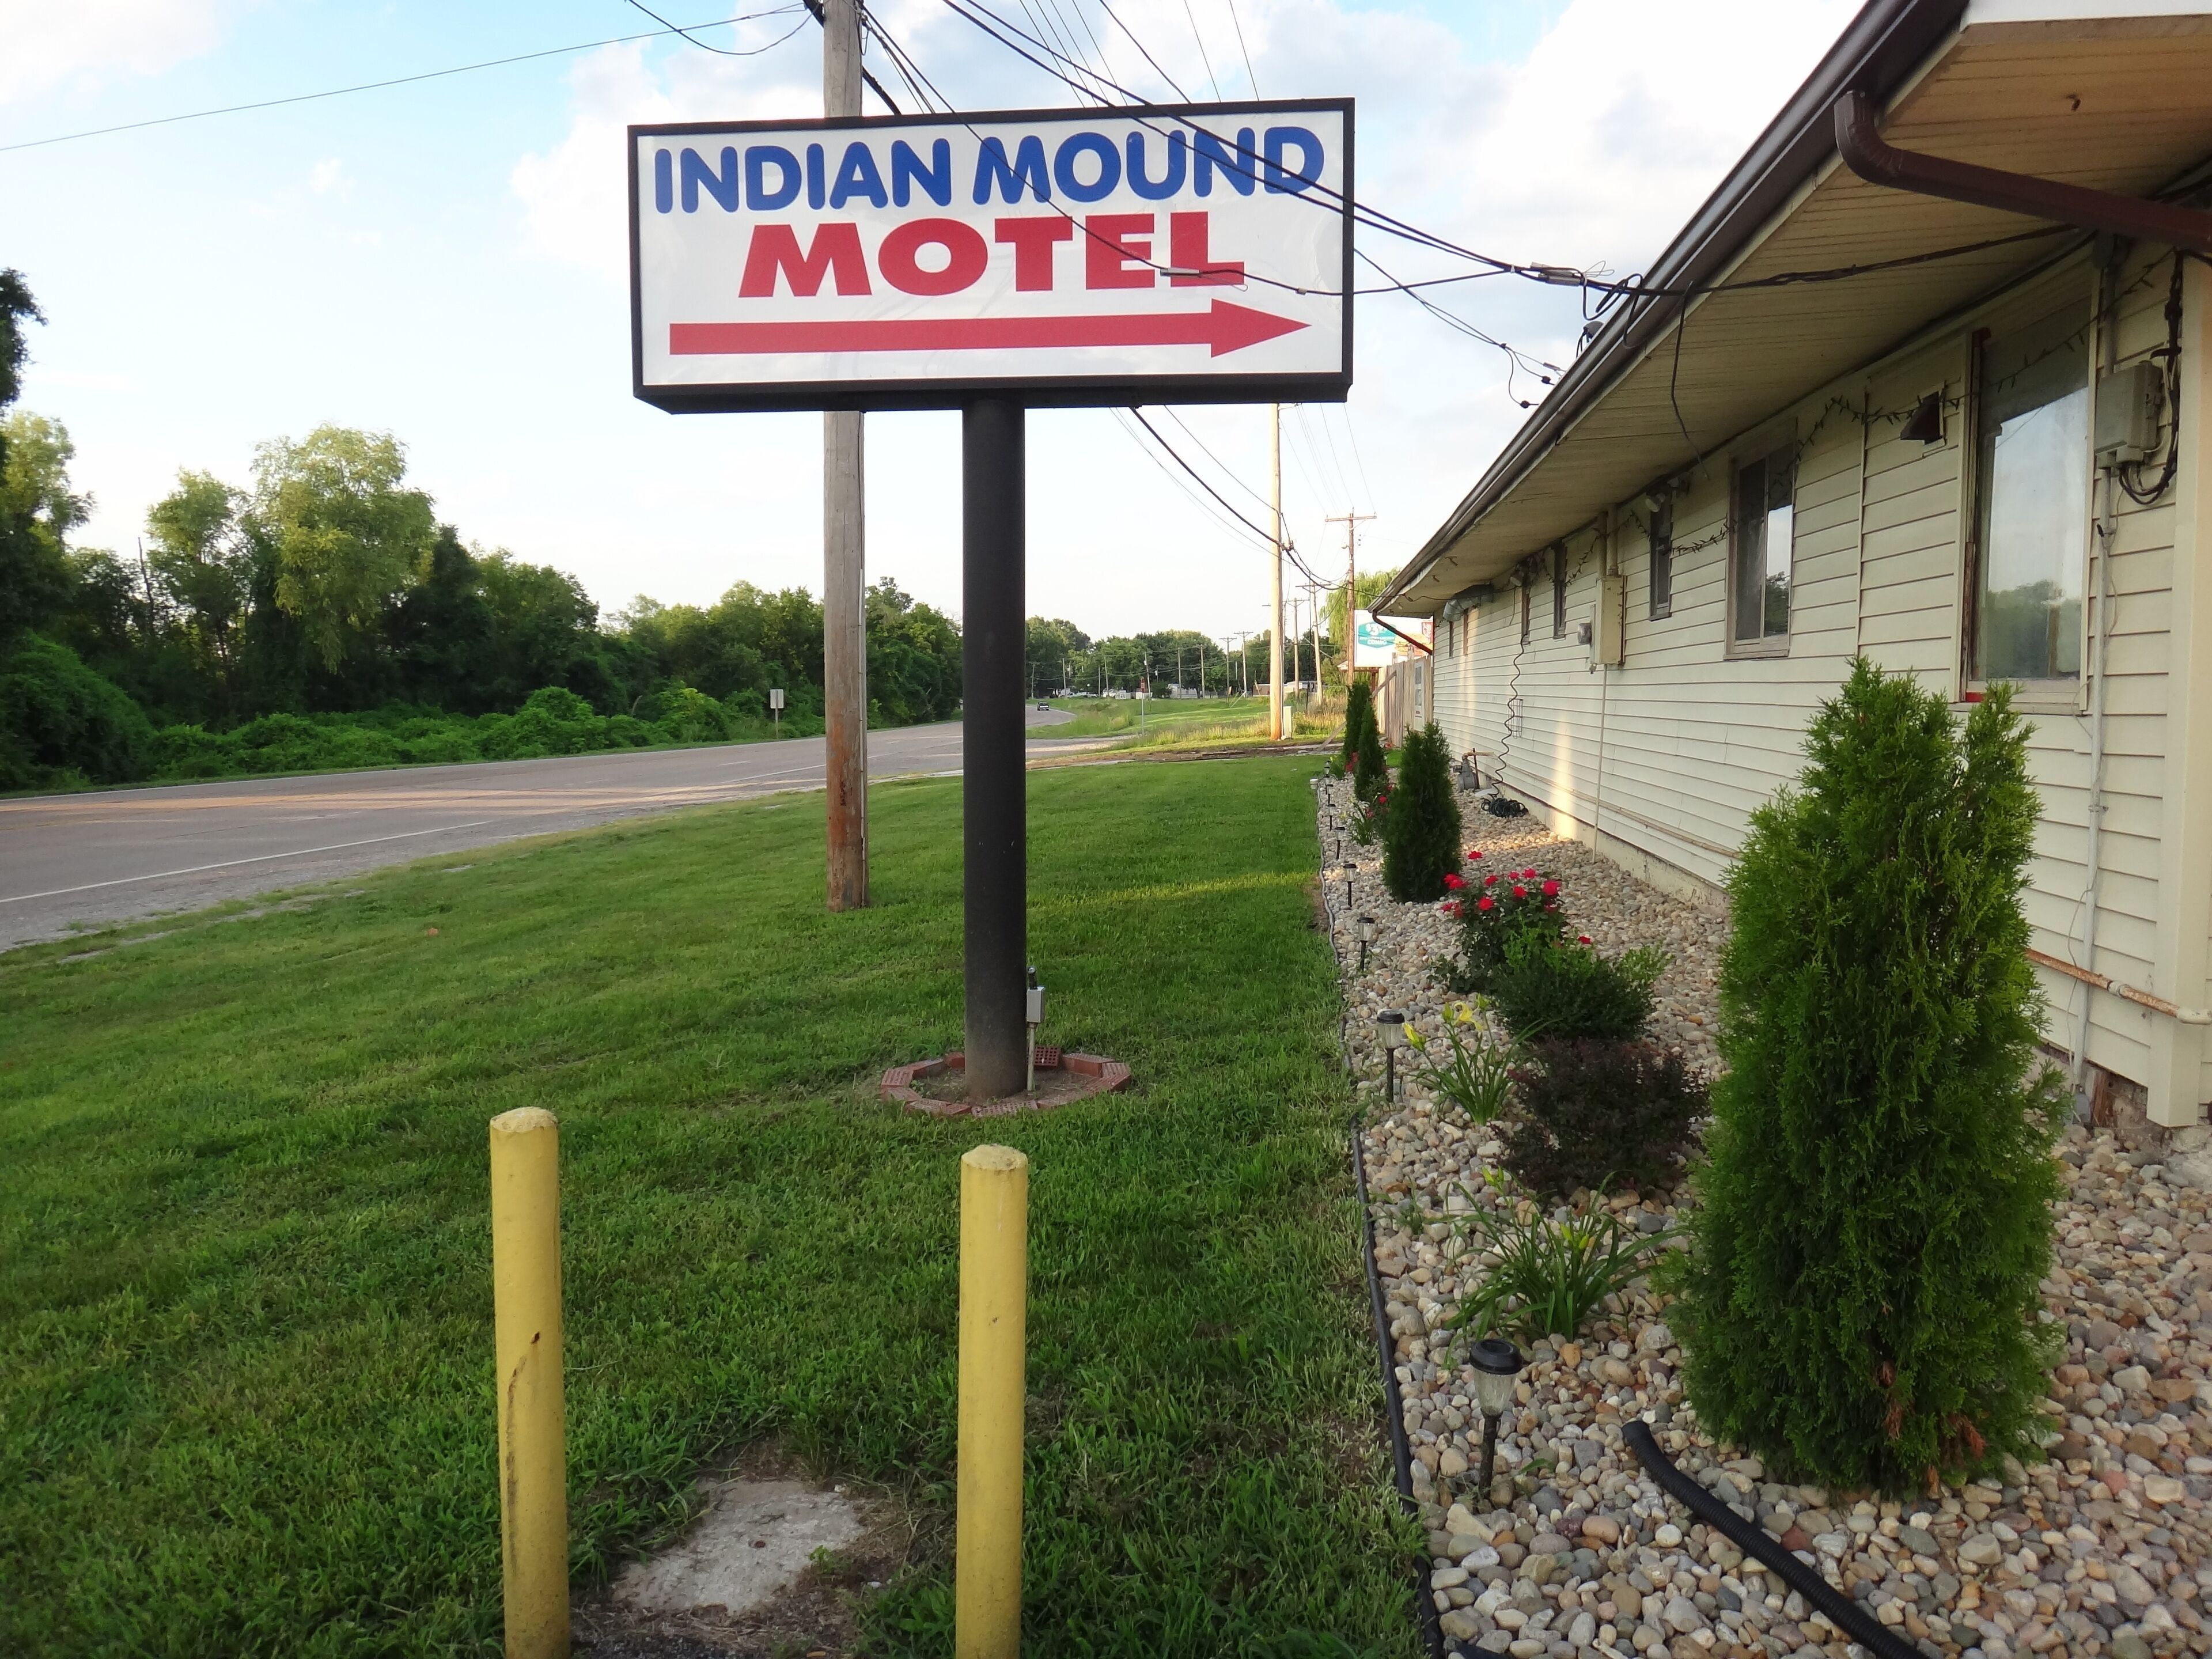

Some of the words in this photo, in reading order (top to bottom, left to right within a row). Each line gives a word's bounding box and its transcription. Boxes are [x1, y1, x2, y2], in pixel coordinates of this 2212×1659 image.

[655, 138, 952, 214] INDIAN
[972, 126, 1325, 205] MOUND
[738, 211, 1245, 297] MOTEL
